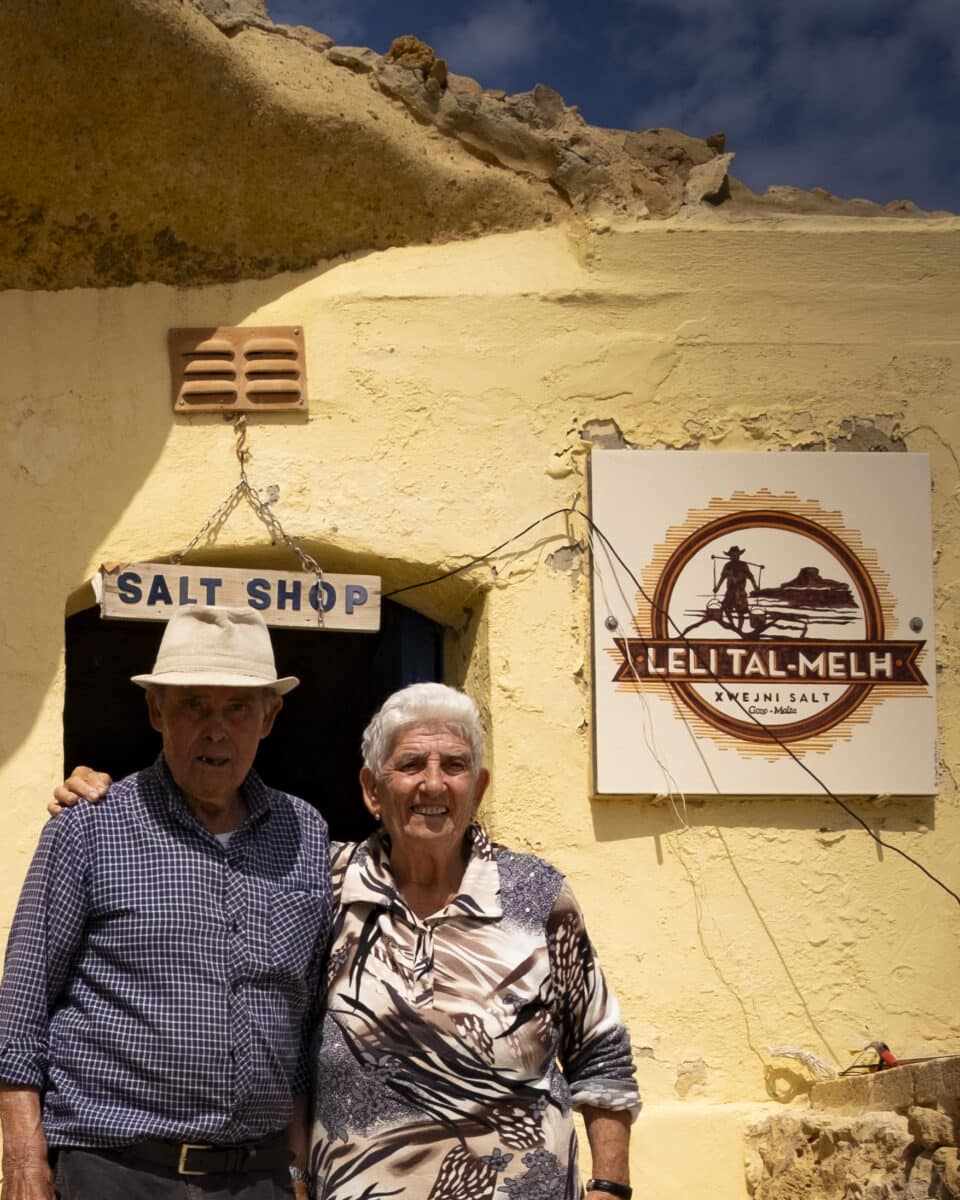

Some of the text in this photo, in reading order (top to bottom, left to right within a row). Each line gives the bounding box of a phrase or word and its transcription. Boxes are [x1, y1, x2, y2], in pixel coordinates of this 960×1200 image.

[117, 572, 369, 615] SALT SHOP
[647, 647, 894, 679] LELI TAL-MELH
[715, 691, 830, 704] XWEJNI SALT
